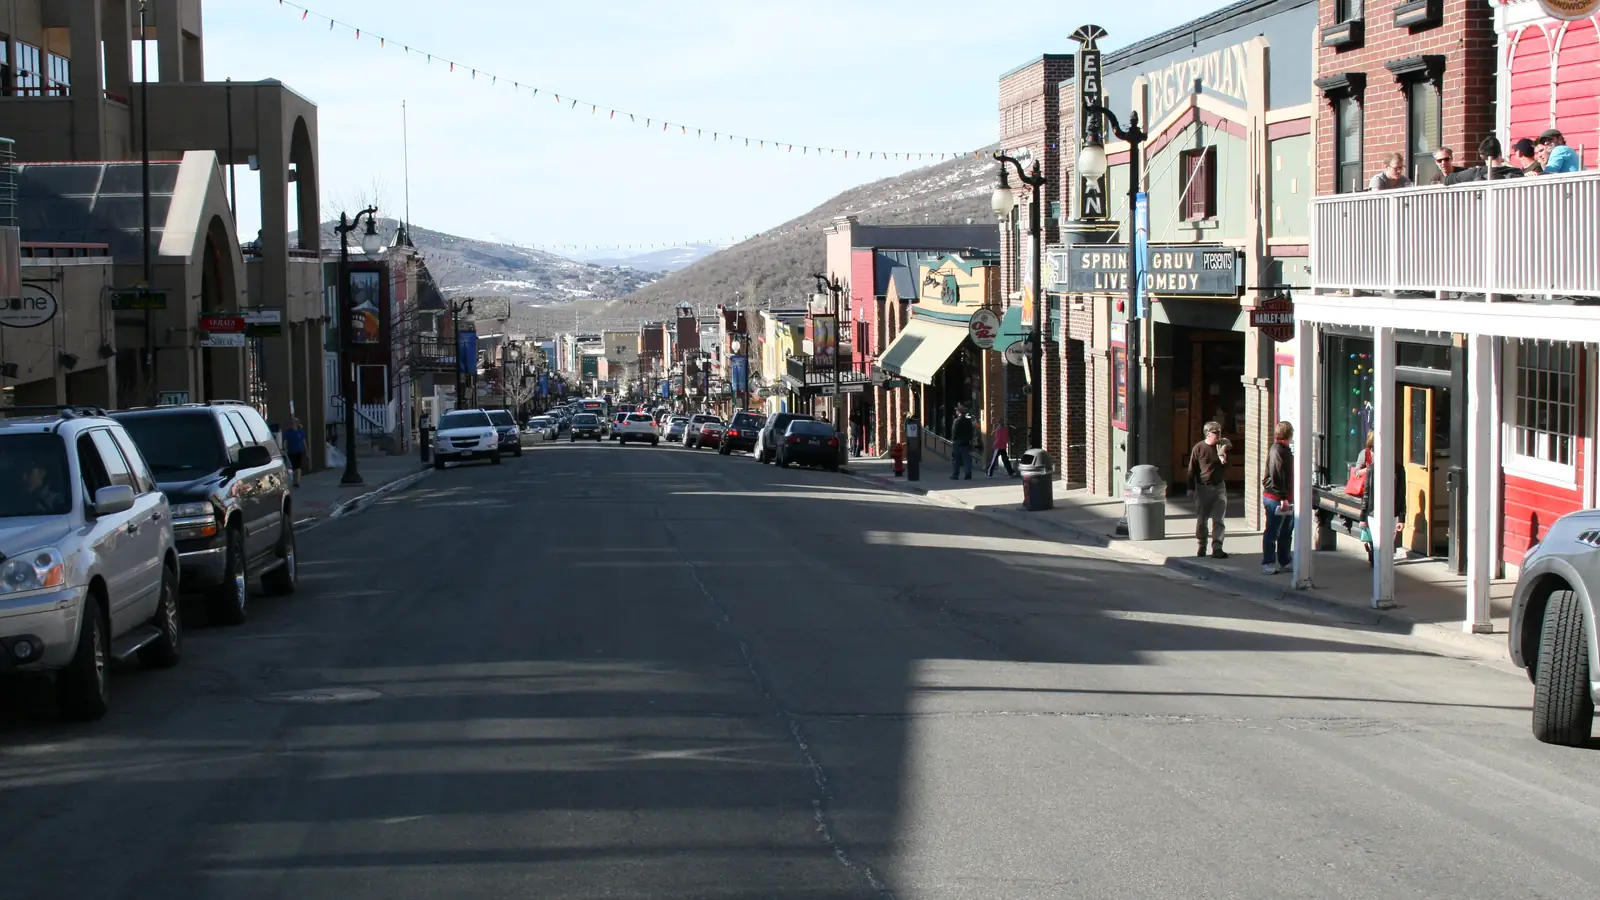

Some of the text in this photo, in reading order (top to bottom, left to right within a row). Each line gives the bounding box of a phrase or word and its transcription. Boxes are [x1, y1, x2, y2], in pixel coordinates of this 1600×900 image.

[1148, 44, 1247, 128] EGYPTIAN
[1084, 55, 1102, 214] EGYAN
[1081, 252, 1128, 269] SPRIN
[1153, 252, 1194, 269] GRUV
[1094, 272, 1199, 290] LIVE OMEDY
[1254, 312, 1294, 324] HARLEY-DAV
[162, 392, 189, 404] ATM
